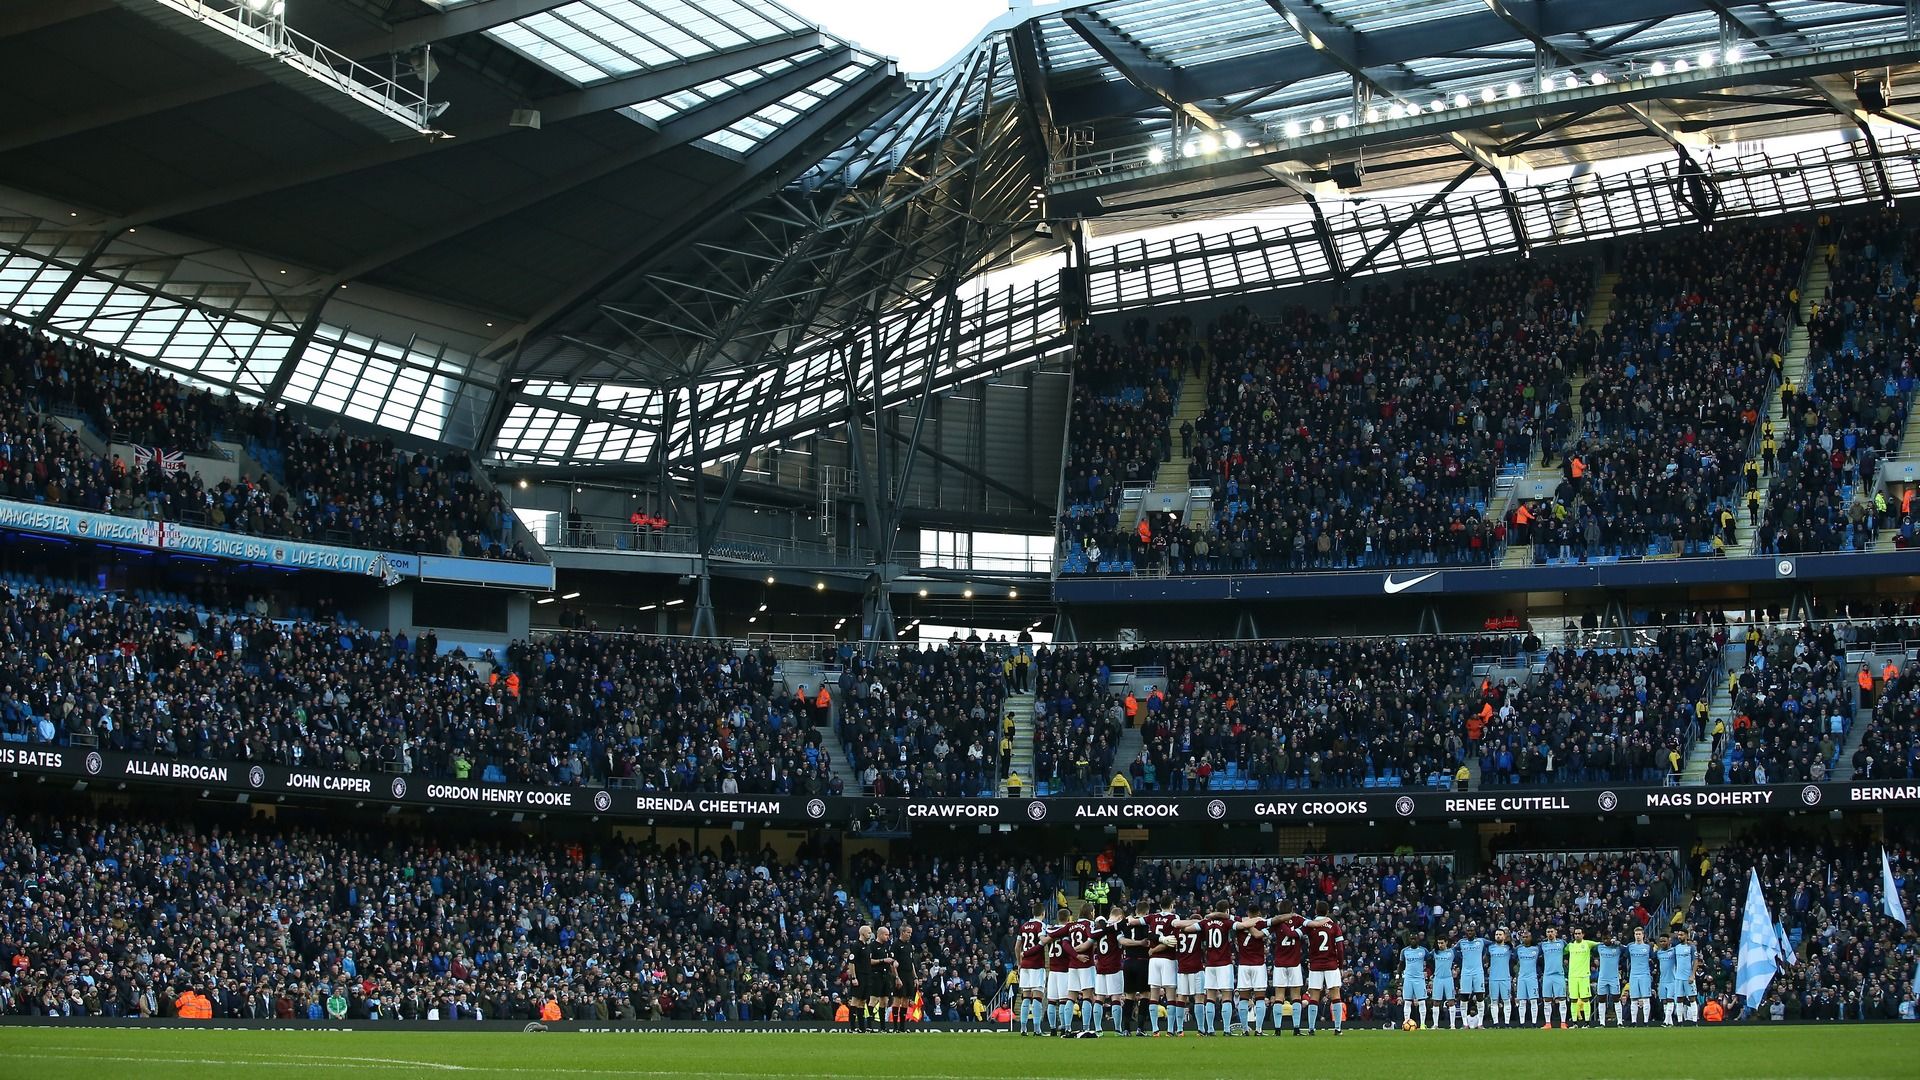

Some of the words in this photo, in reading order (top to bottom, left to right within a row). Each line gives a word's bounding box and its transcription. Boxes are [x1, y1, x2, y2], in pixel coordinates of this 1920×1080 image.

[212, 537, 243, 556] SINCE
[244, 543, 268, 560] 1894
[292, 549, 316, 566] LIVE
[317, 552, 340, 570] FOR
[341, 555, 367, 571] CITY
[19, 750, 62, 768] BATES
[125, 760, 169, 776] ALLAN
[172, 764, 228, 781] BROGAN
[286, 773, 320, 788] JOHN
[323, 776, 371, 792] CAPPER
[427, 784, 478, 800] GORDON
[482, 788, 523, 803] HENRY
[526, 792, 571, 806] COOKE
[1646, 793, 1692, 807] MAGS
[1696, 790, 1773, 806] DOHERTY
[1851, 786, 1920, 800] BERNAR
[636, 796, 695, 812] BRENDA
[699, 799, 780, 814] CHEETHAM
[907, 804, 999, 817] CRAWFORD
[1075, 804, 1118, 817] ALAN
[1122, 804, 1179, 817] CROOK
[1254, 802, 1298, 815] GARY
[1302, 801, 1368, 815] CROOKS
[1445, 798, 1496, 812] RENEE
[1500, 796, 1570, 811] CUTTELL
[1022, 932, 1036, 951] 23
[1070, 931, 1083, 948] 13
[1099, 935, 1108, 954] 6
[1178, 933, 1197, 953] 37
[1208, 928, 1222, 948] 10
[1318, 931, 1329, 951] 2
[1049, 940, 1062, 957] 25
